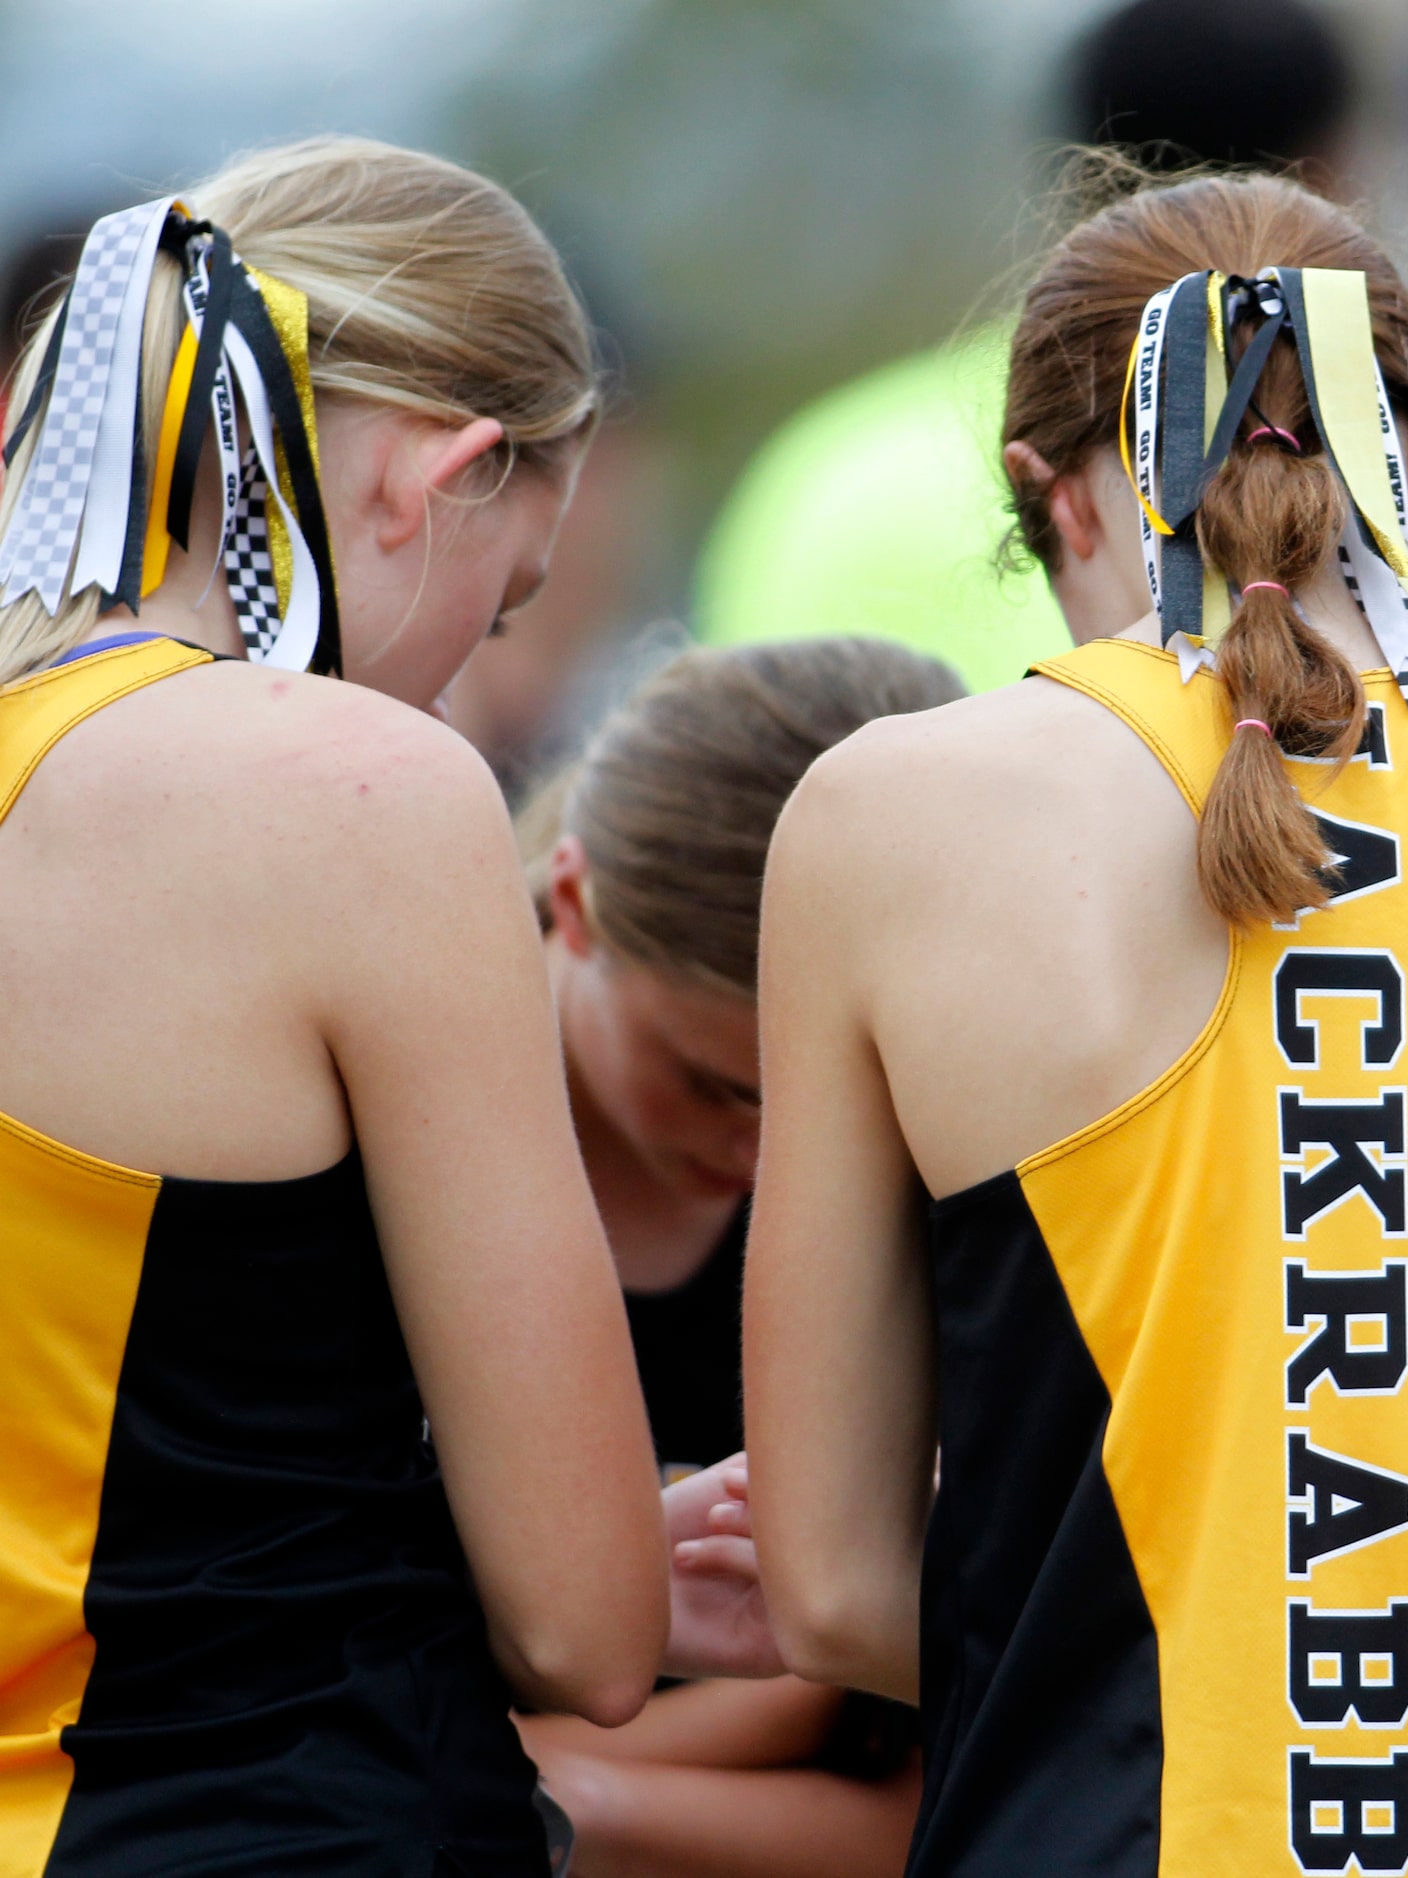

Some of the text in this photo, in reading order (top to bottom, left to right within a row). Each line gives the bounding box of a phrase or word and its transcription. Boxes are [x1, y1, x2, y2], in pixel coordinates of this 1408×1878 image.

[1145, 307, 1162, 335] GO
[1139, 340, 1157, 411] TEAM!
[1139, 429, 1150, 462] GO
[227, 472, 237, 508] GO
